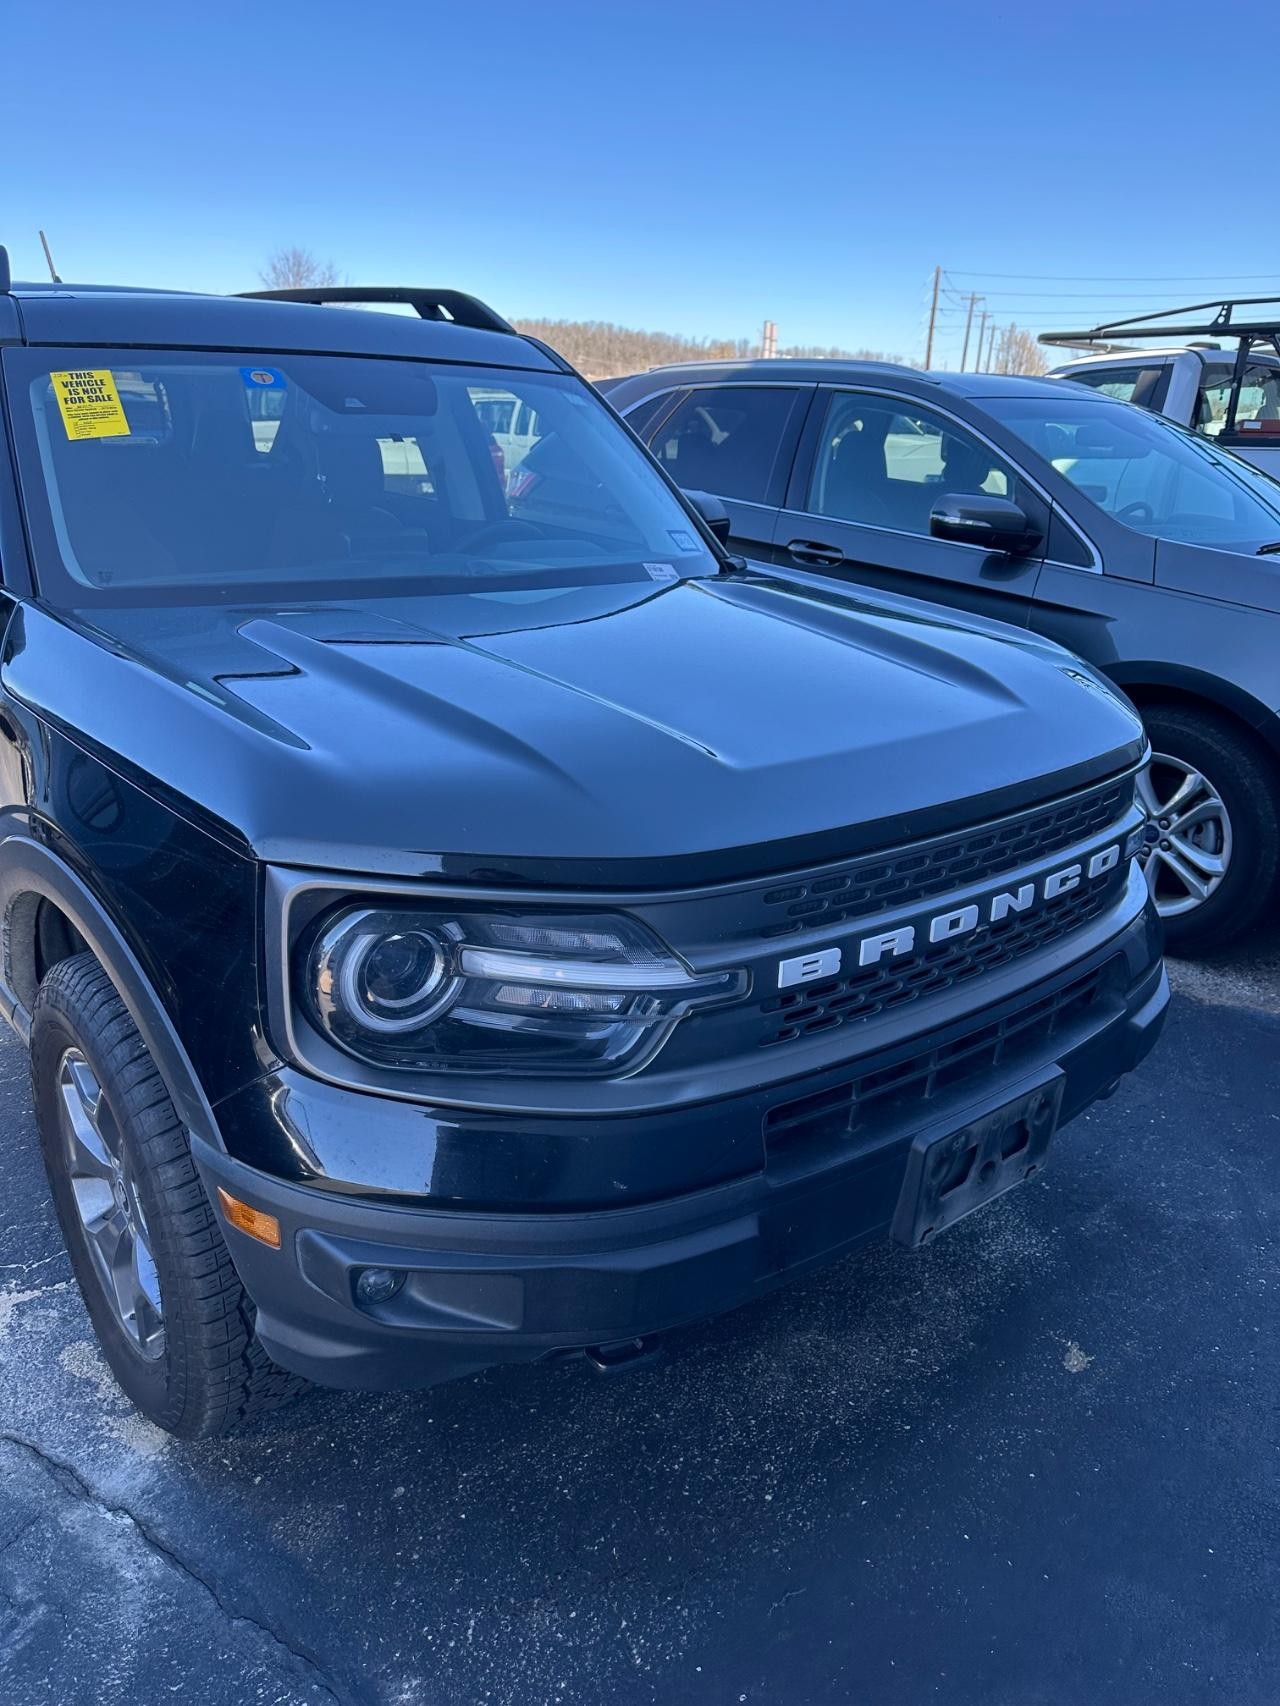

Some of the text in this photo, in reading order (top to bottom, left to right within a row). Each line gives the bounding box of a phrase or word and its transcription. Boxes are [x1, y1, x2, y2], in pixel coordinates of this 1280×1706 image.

[68, 372, 94, 380] THIS
[62, 379, 105, 388] VEHICLE
[68, 387, 103, 396] IS NOT
[87, 395, 113, 403] SALE
[777, 844, 1120, 988] BRONCO
